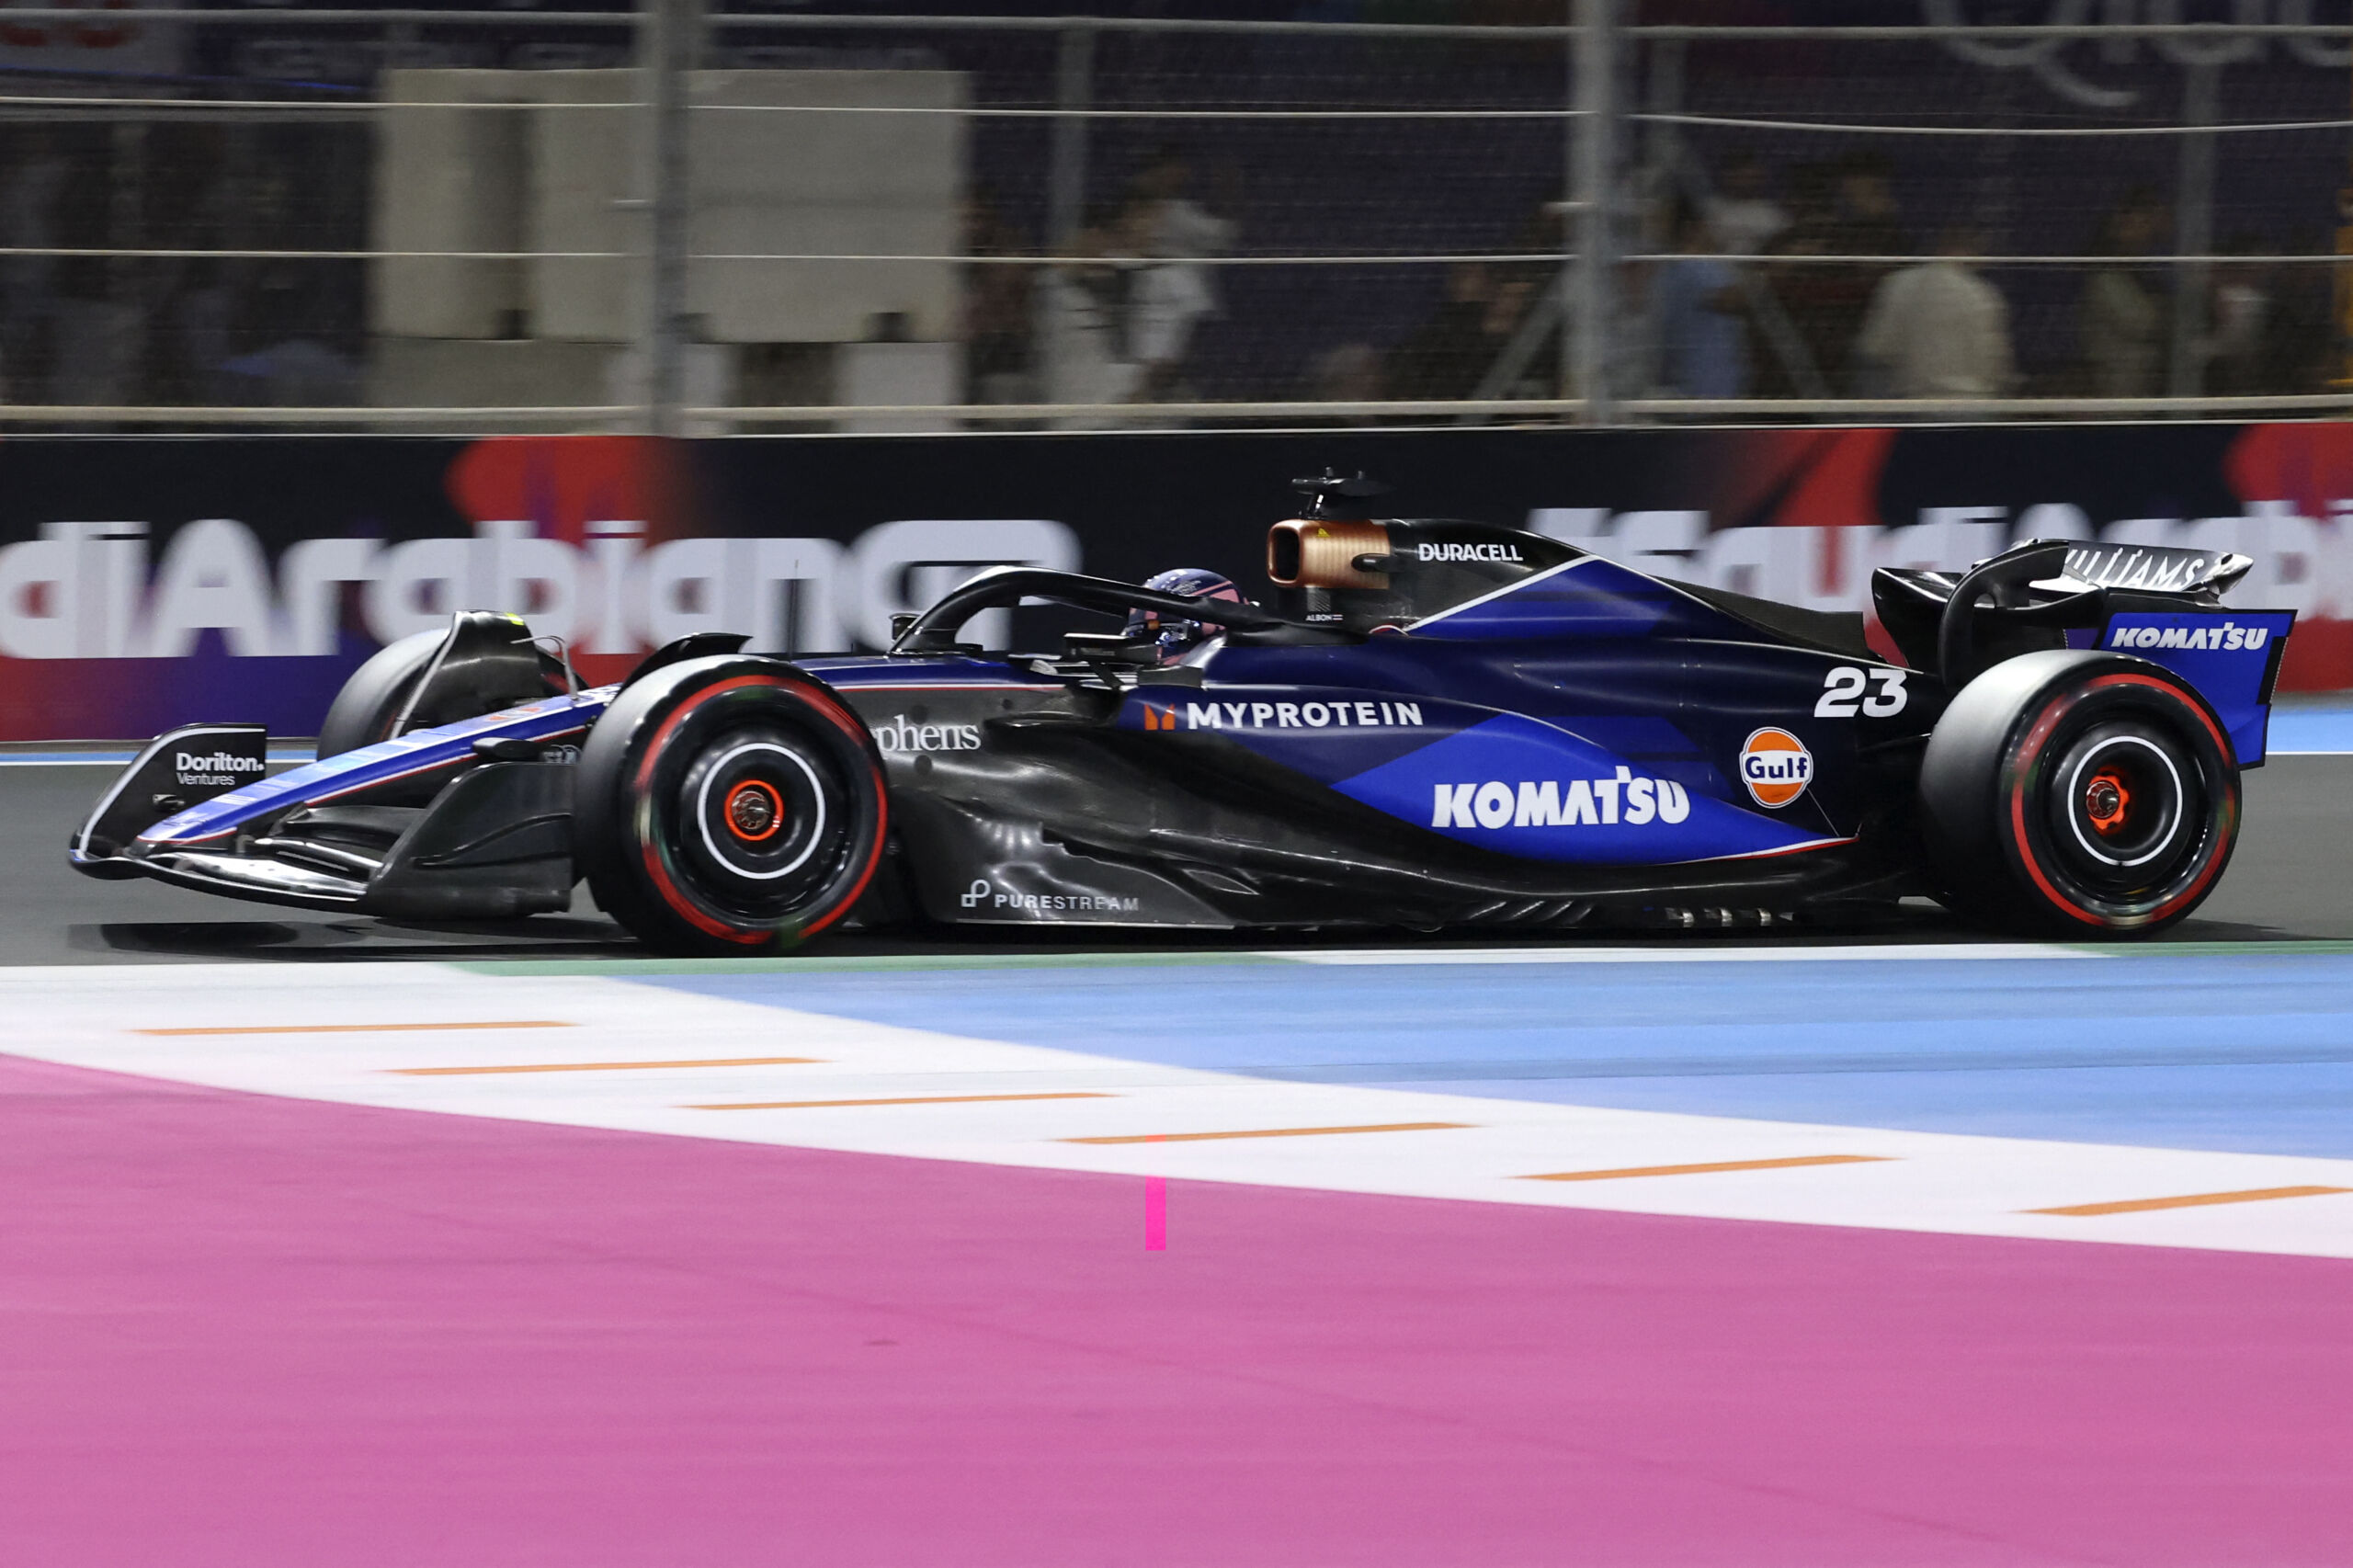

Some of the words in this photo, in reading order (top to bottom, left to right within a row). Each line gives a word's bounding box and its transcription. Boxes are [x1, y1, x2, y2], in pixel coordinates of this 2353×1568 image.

[1418, 543, 1524, 562] DURACELL
[2064, 547, 2204, 591] ILLIAMS
[2111, 622, 2268, 650] KOMATSU
[1813, 666, 1909, 718] 23
[1187, 701, 1423, 730] MYPROTEIN
[176, 772, 235, 786] Ventures
[1745, 756, 1808, 778] Gulf
[1432, 766, 1690, 829] KOMATSU
[994, 893, 1140, 912] PURESTREAM
